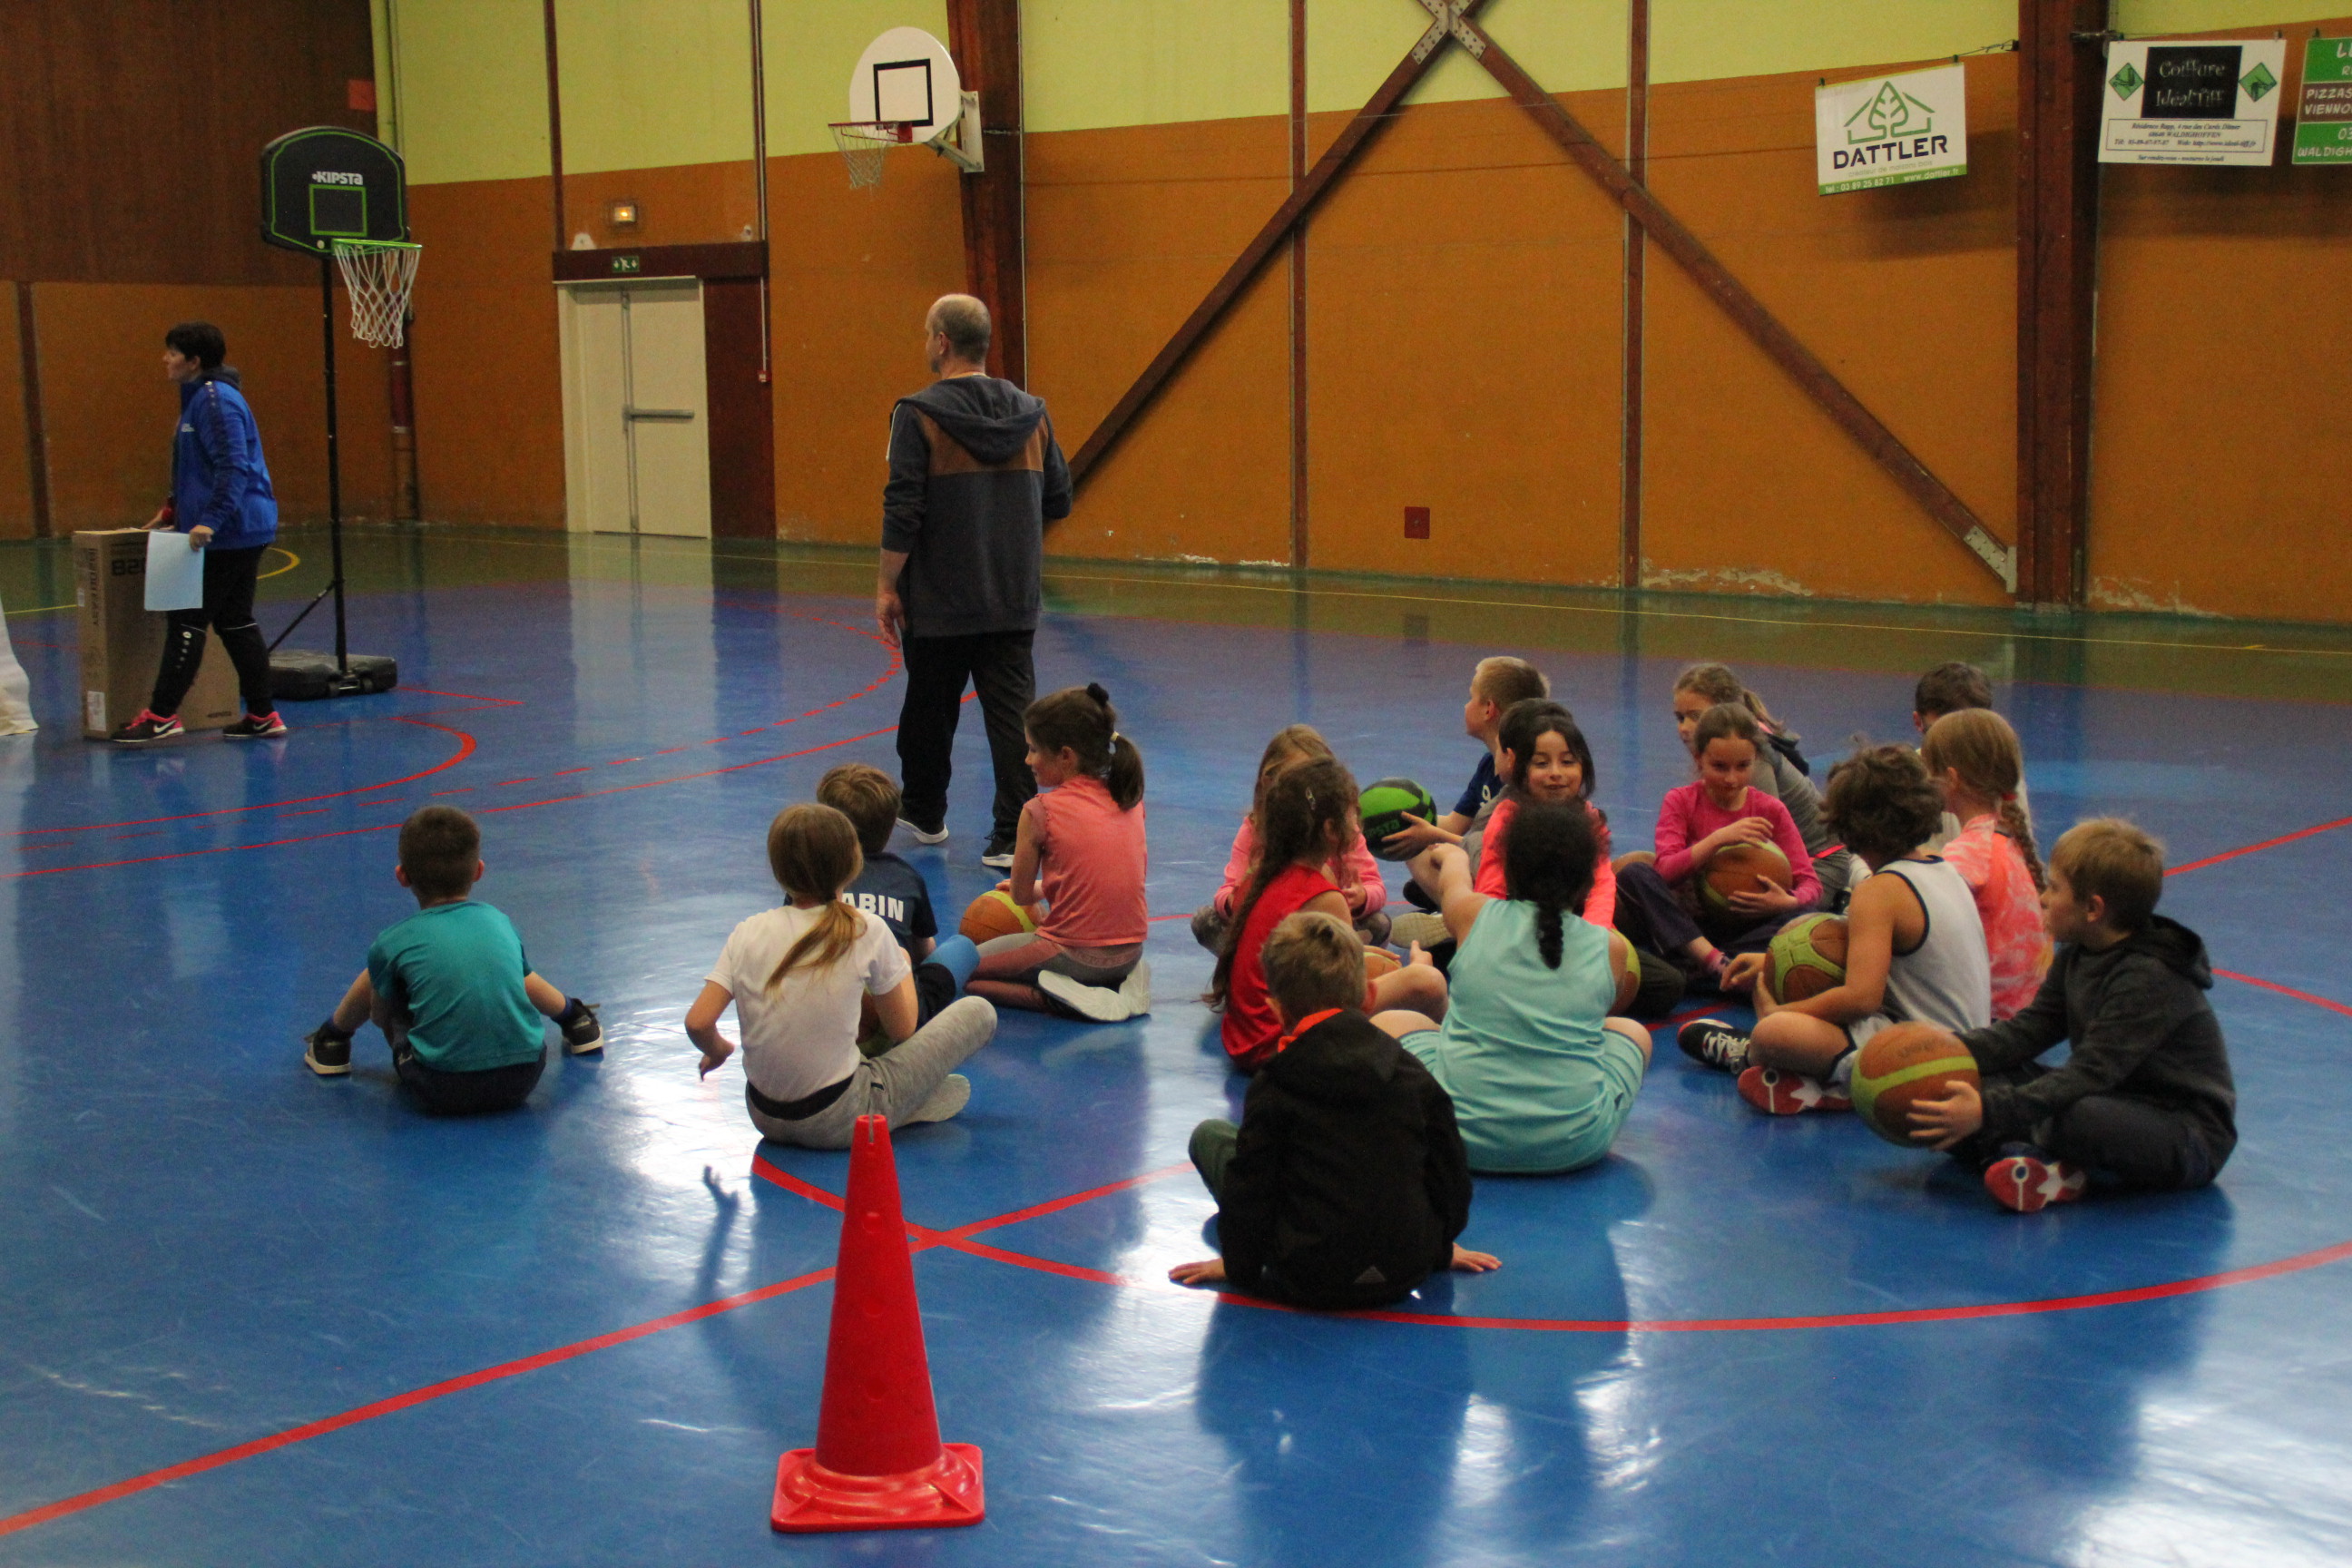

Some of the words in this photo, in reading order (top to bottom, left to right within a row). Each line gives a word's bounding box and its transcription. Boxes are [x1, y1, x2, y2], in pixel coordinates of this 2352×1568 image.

[2337, 42, 2352, 58] L
[2342, 65, 2352, 75] R
[2305, 103, 2352, 115] VIENNO
[1833, 135, 1948, 169] DATTLER
[1904, 168, 1959, 182] www.dattler.fr
[112, 558, 146, 576] B2
